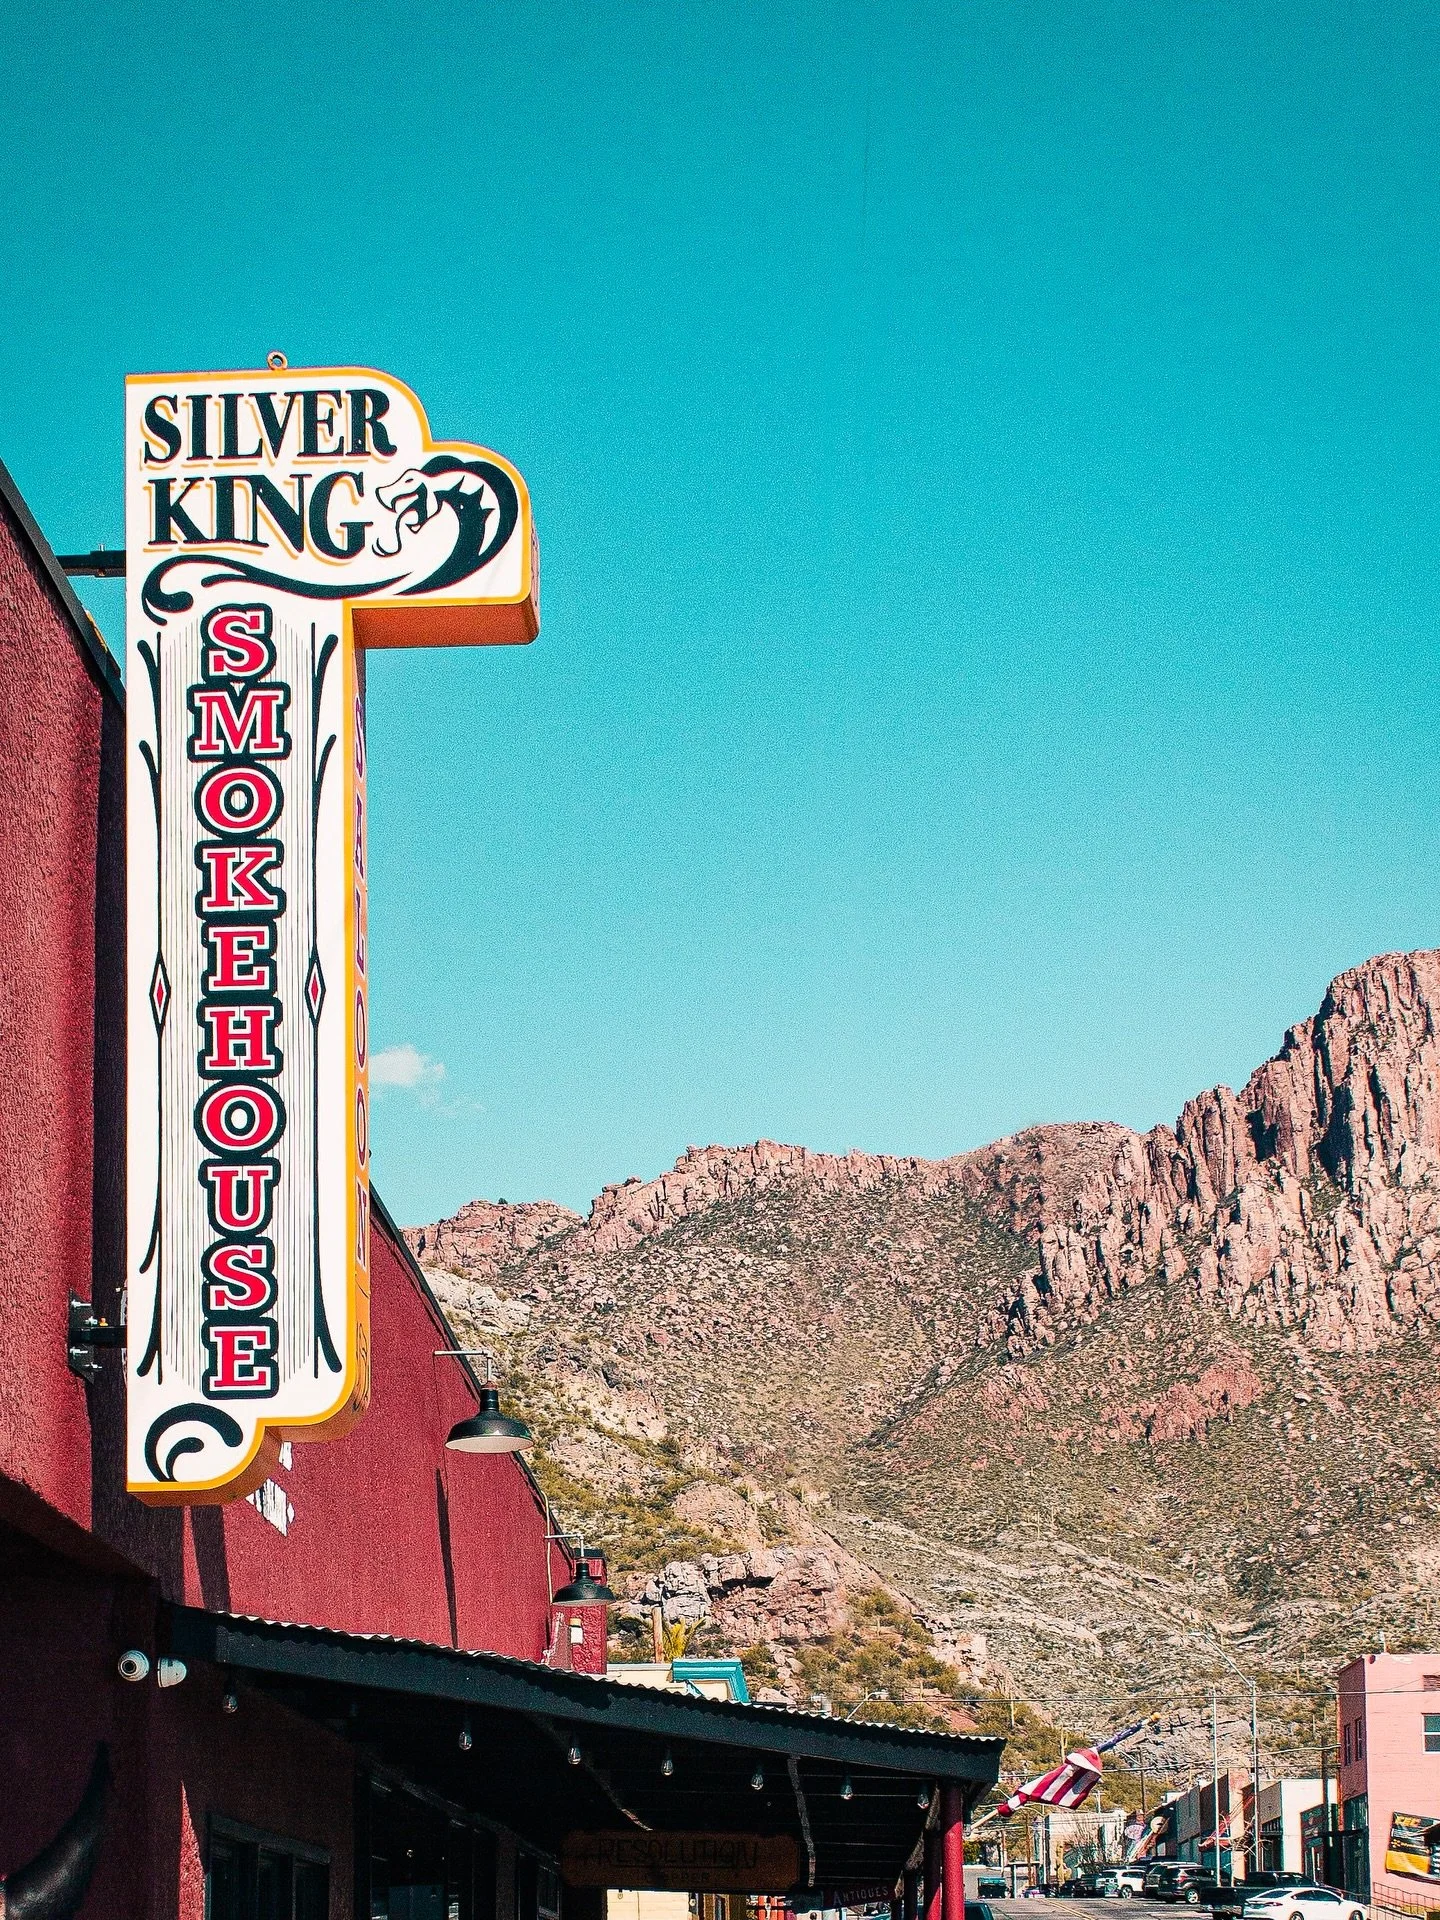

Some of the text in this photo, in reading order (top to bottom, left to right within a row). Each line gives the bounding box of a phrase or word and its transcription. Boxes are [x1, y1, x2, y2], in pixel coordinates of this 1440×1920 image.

[141, 388, 398, 466] SILVER
[146, 471, 374, 561] KING
[190, 606, 287, 1396] SMOKEHOUSE
[355, 694, 367, 1271] SALOON
[597, 1838, 758, 1869] RESOLUTION
[832, 1886, 889, 1906] ANTIQUES
